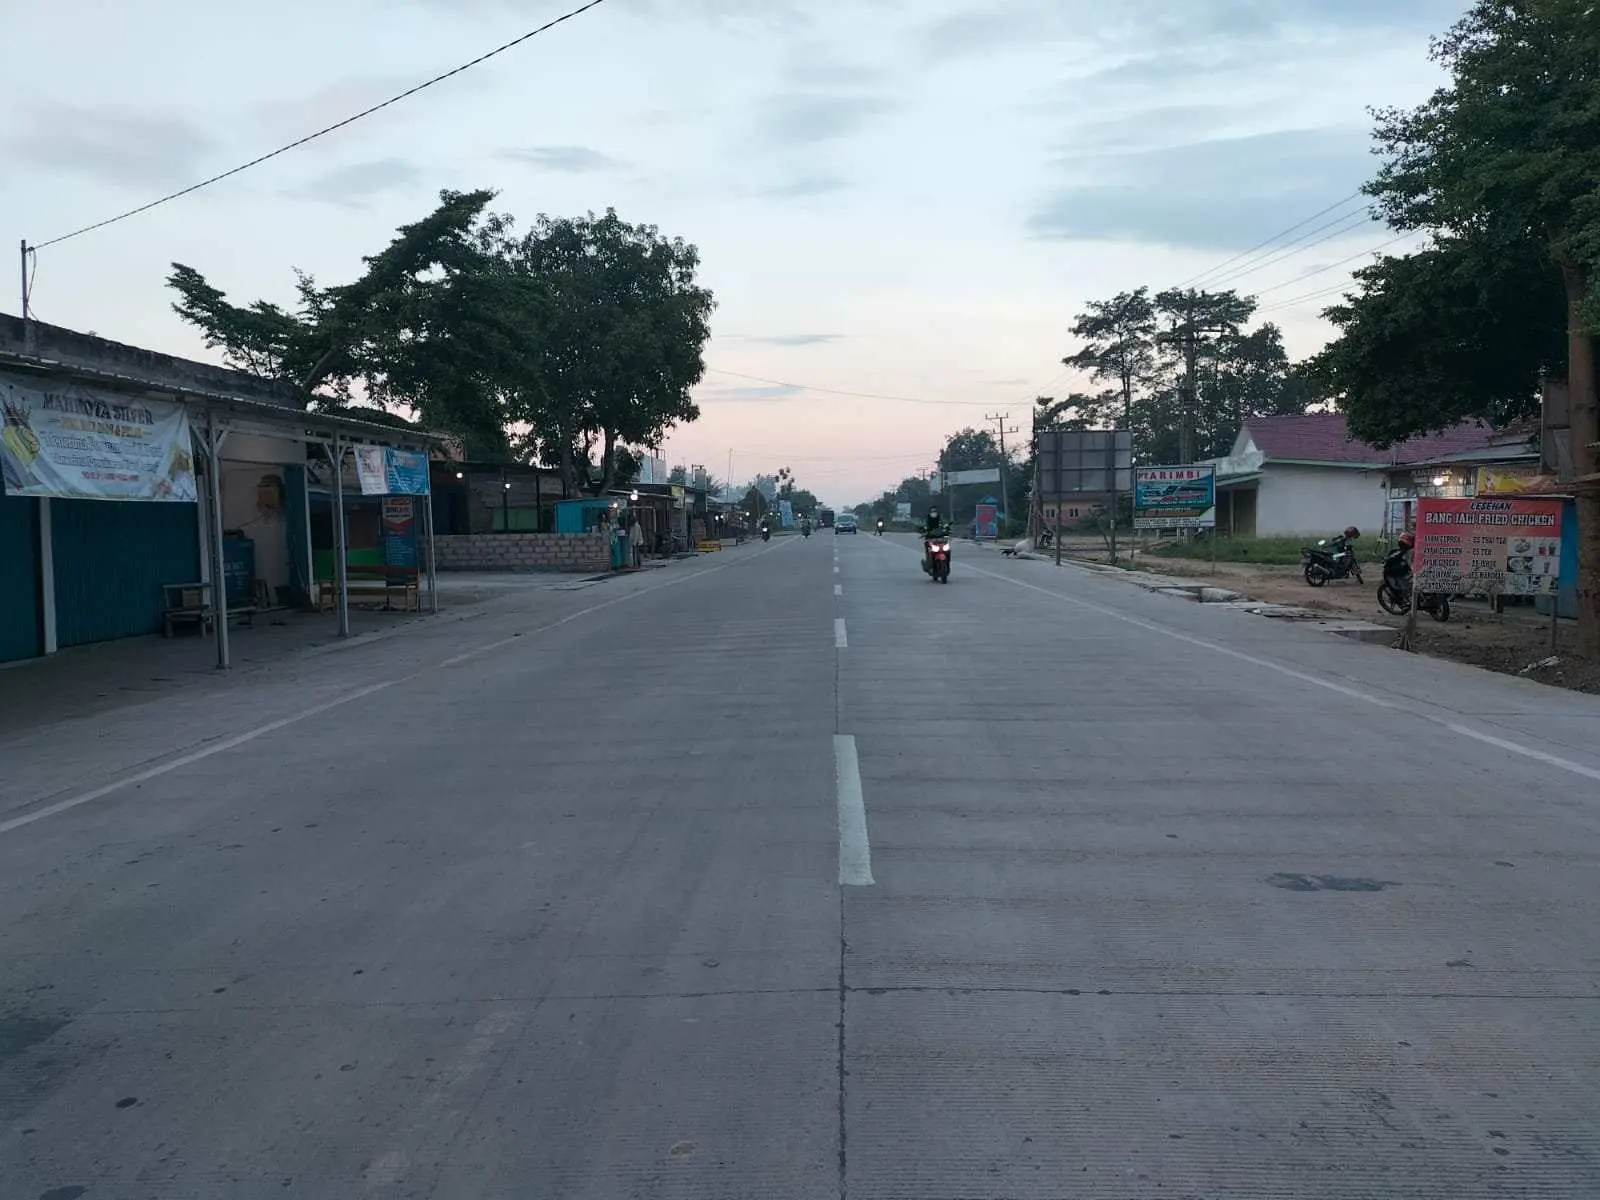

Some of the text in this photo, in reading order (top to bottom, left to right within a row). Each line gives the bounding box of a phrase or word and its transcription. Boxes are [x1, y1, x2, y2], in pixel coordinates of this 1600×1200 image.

[1471, 502, 1512, 511] LESEHAN
[1425, 511, 1452, 524] BANG
[1476, 512, 1508, 525] FRIED
[1511, 513, 1555, 526] CHICKEN
